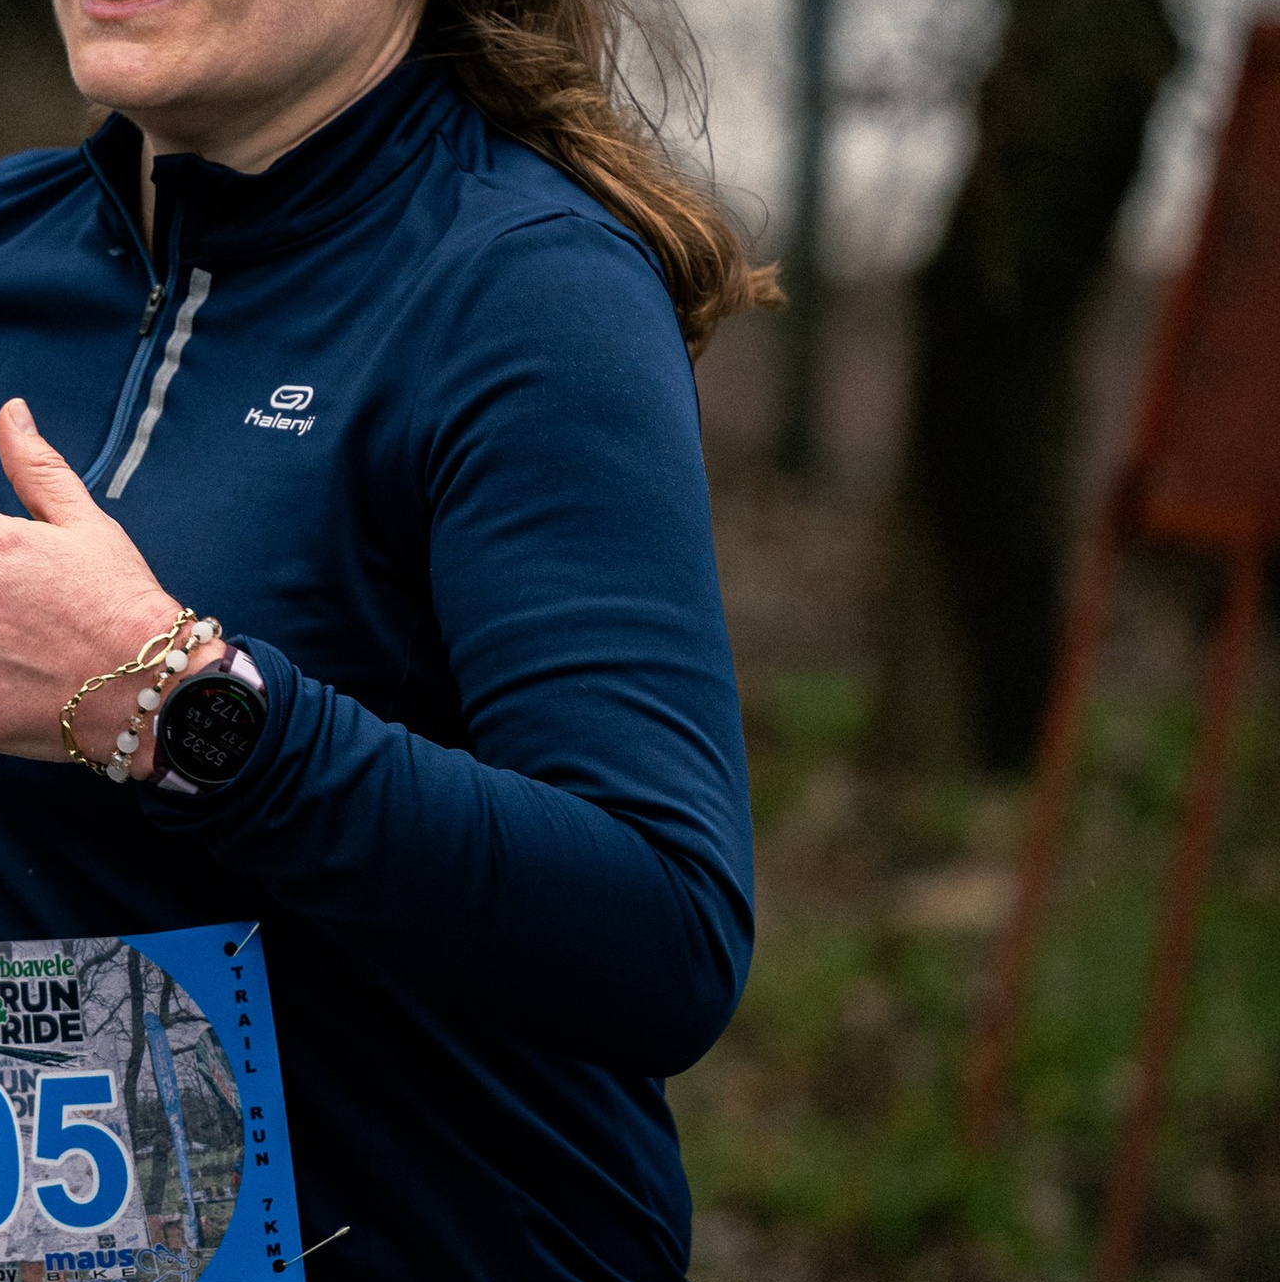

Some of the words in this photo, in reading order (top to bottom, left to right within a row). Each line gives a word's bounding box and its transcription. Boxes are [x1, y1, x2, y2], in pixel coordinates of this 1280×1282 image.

[244, 407, 316, 437] Kalenji
[210, 696, 241, 723] 172
[182, 731, 228, 767] 52:32
[1, 1013, 84, 1045] RIDE
[231, 965, 257, 1074] TRAIL
[250, 1105, 270, 1167] RUN
[262, 1197, 283, 1258] 7KM
[44, 1248, 135, 1272] maus
[47, 1266, 137, 1282] BIKE
